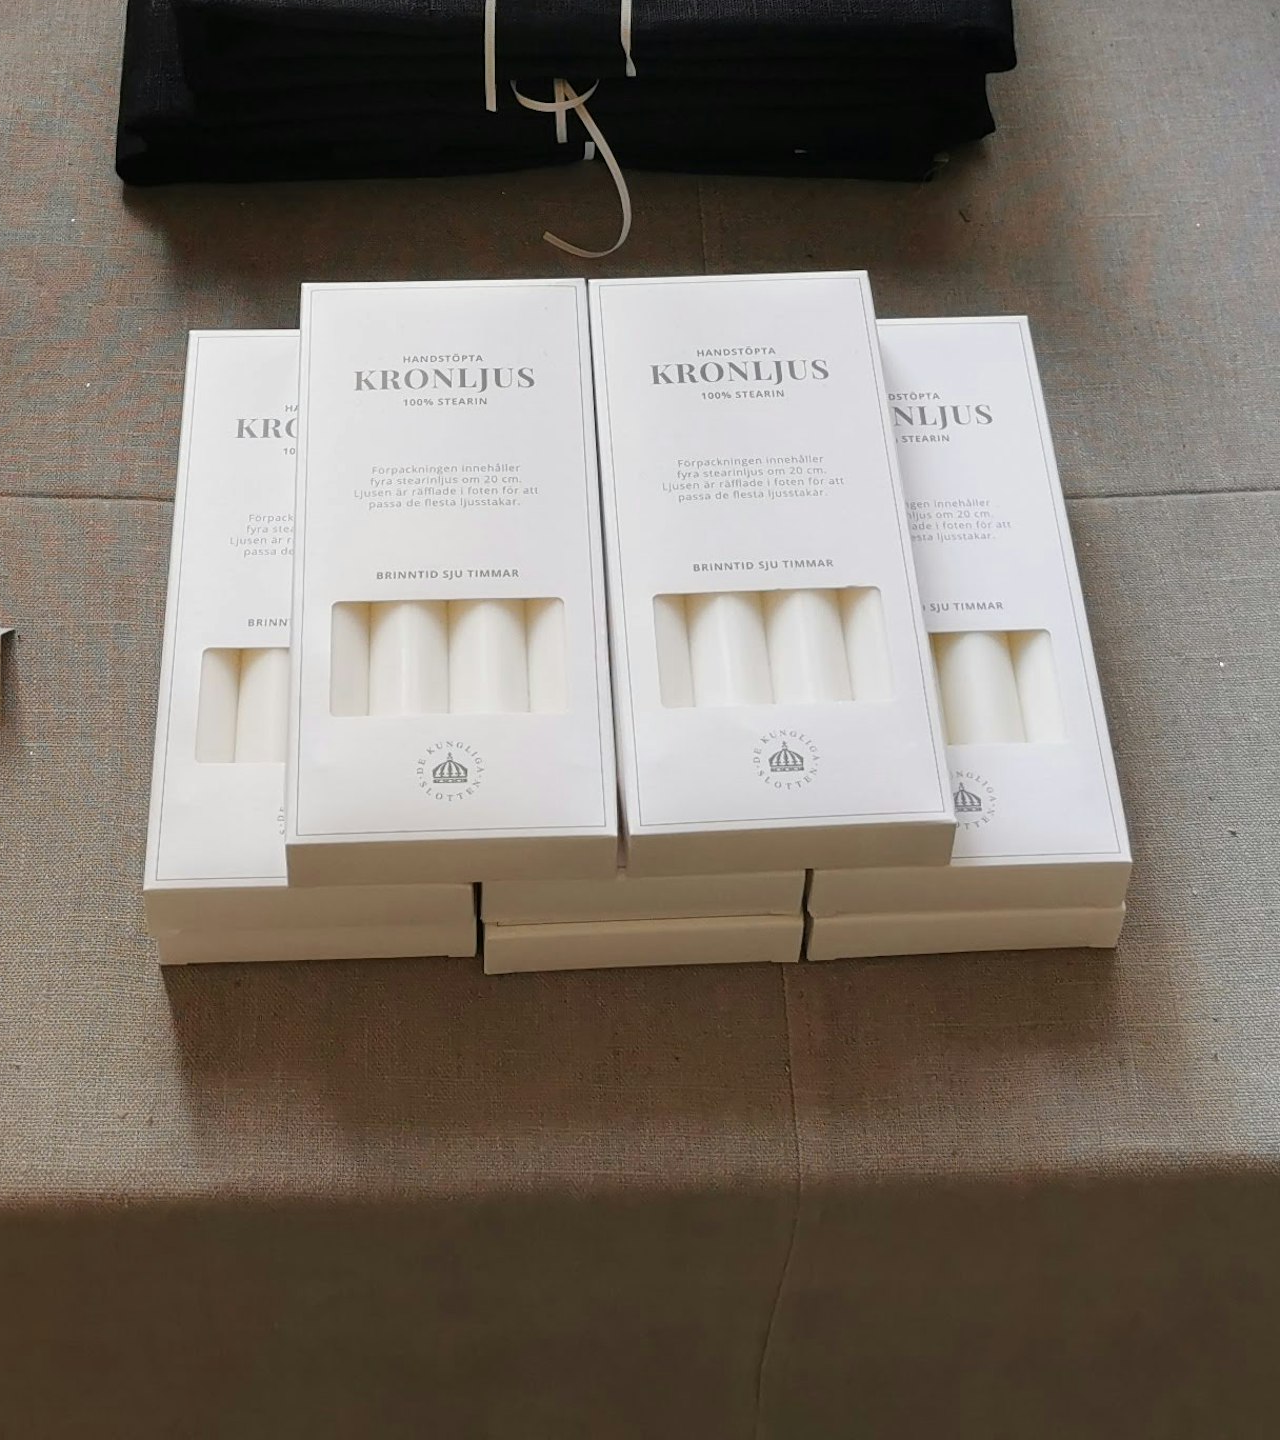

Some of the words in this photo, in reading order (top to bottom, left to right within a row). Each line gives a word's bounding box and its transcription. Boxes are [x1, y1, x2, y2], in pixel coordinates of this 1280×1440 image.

[697, 347, 776, 356] HANDSTÖPTA
[403, 354, 484, 362] HANDSTÖPTA
[651, 361, 829, 384] KRONLJUS
[355, 368, 535, 392] KRONLJUS
[736, 390, 784, 398] STEARIN
[894, 406, 993, 428] NLJUS
[901, 435, 950, 443] STEARIN
[678, 458, 762, 468] Förpackningen
[766, 455, 823, 468] innehåller
[372, 466, 458, 475] Förpackningen
[462, 464, 520, 476] innehåller
[677, 468, 699, 480] fyra
[703, 469, 765, 479] stearinljus
[767, 469, 786, 479] om
[790, 466, 802, 474] 20
[370, 478, 393, 487] fyra
[396, 476, 458, 486] stearinljus
[462, 477, 480, 487] om
[484, 475, 498, 484] 20
[663, 479, 700, 492] Ljusen
[704, 481, 715, 489] är
[720, 479, 763, 488] räfflade
[774, 478, 804, 486] foten
[808, 477, 824, 485] för
[355, 490, 392, 499] Ljusen
[412, 487, 456, 495] räfflade
[468, 487, 498, 495] foten
[502, 486, 519, 494] för
[523, 487, 541, 495] att
[678, 494, 711, 503] passa
[715, 491, 729, 500] de
[733, 490, 764, 499] flesta
[369, 501, 402, 510] passa
[406, 499, 421, 507] de
[425, 499, 456, 507] flesta
[249, 514, 294, 524] Förpack
[693, 562, 754, 571] BRINNTID
[758, 560, 779, 570] SJU
[783, 558, 834, 568] TIMMAR
[377, 571, 438, 579] BRINNTID
[443, 570, 463, 580] SJU
[930, 603, 949, 613] SJU
[953, 602, 1003, 611] TIMMAR
[248, 619, 288, 627] BRINN
